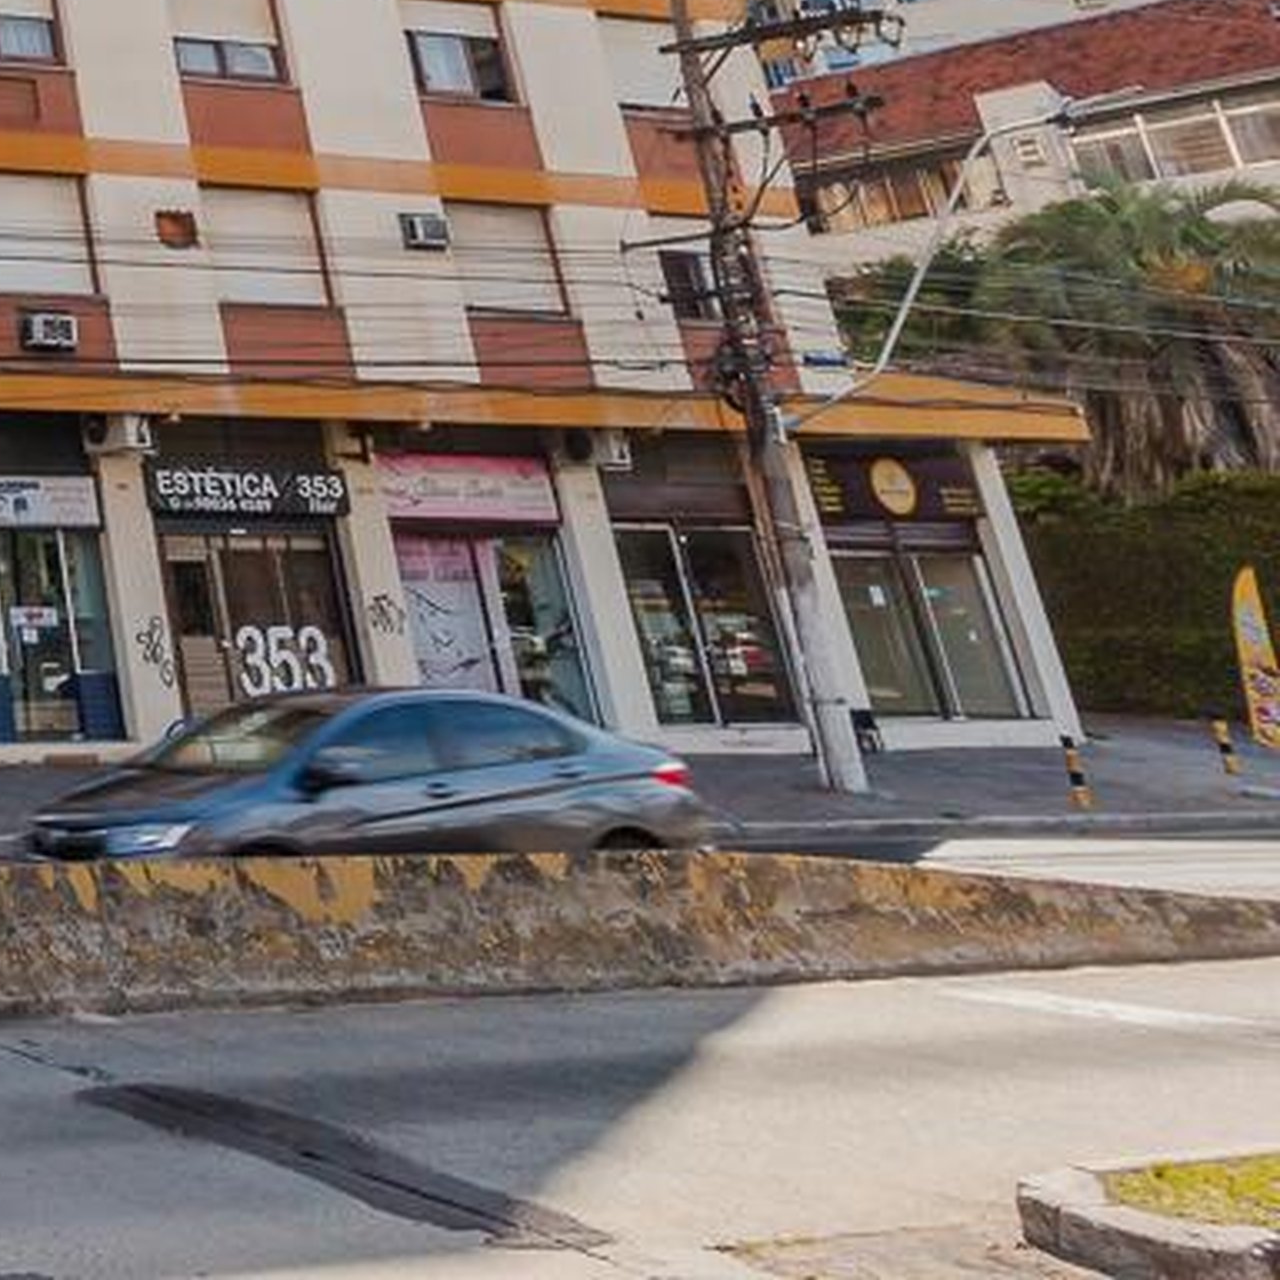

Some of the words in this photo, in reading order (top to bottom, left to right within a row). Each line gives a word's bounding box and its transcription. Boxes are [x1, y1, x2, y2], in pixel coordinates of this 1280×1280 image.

[155, 466, 280, 498] ESTÉTICA
[296, 475, 344, 498] 353
[236, 625, 336, 697] 353
